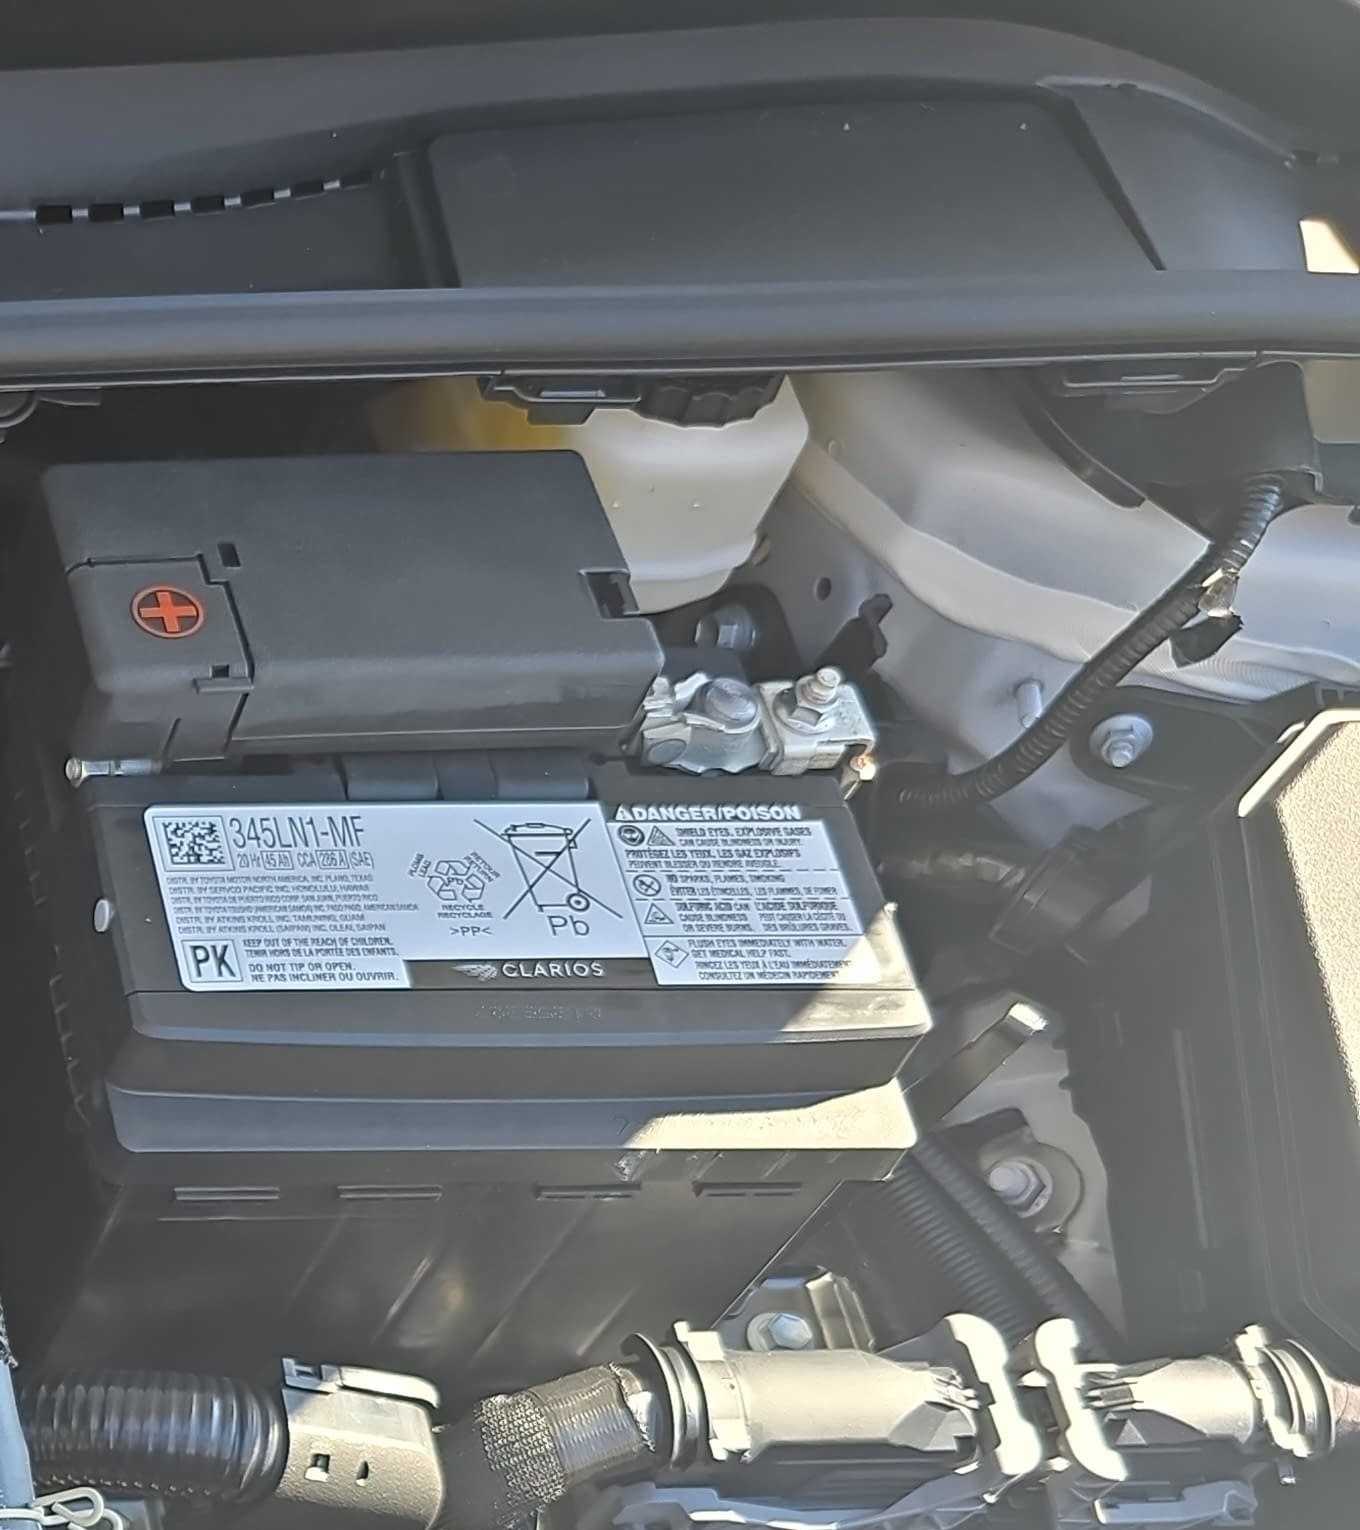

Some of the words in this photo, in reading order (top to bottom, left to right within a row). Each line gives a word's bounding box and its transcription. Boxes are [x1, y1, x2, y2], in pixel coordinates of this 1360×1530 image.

[631, 805, 801, 820] DANGER/POISON
[229, 816, 365, 848] 345LN1-MF
[297, 852, 316, 867] CCA
[450, 926, 492, 937] >PP<
[547, 915, 590, 936] Pb
[189, 945, 236, 978] PK
[248, 963, 263, 973] DO
[266, 963, 286, 973] NOT
[289, 963, 305, 973] TIP
[307, 962, 323, 972] OR
[325, 962, 356, 972] OPEN.
[502, 962, 605, 977] CLARIOS
